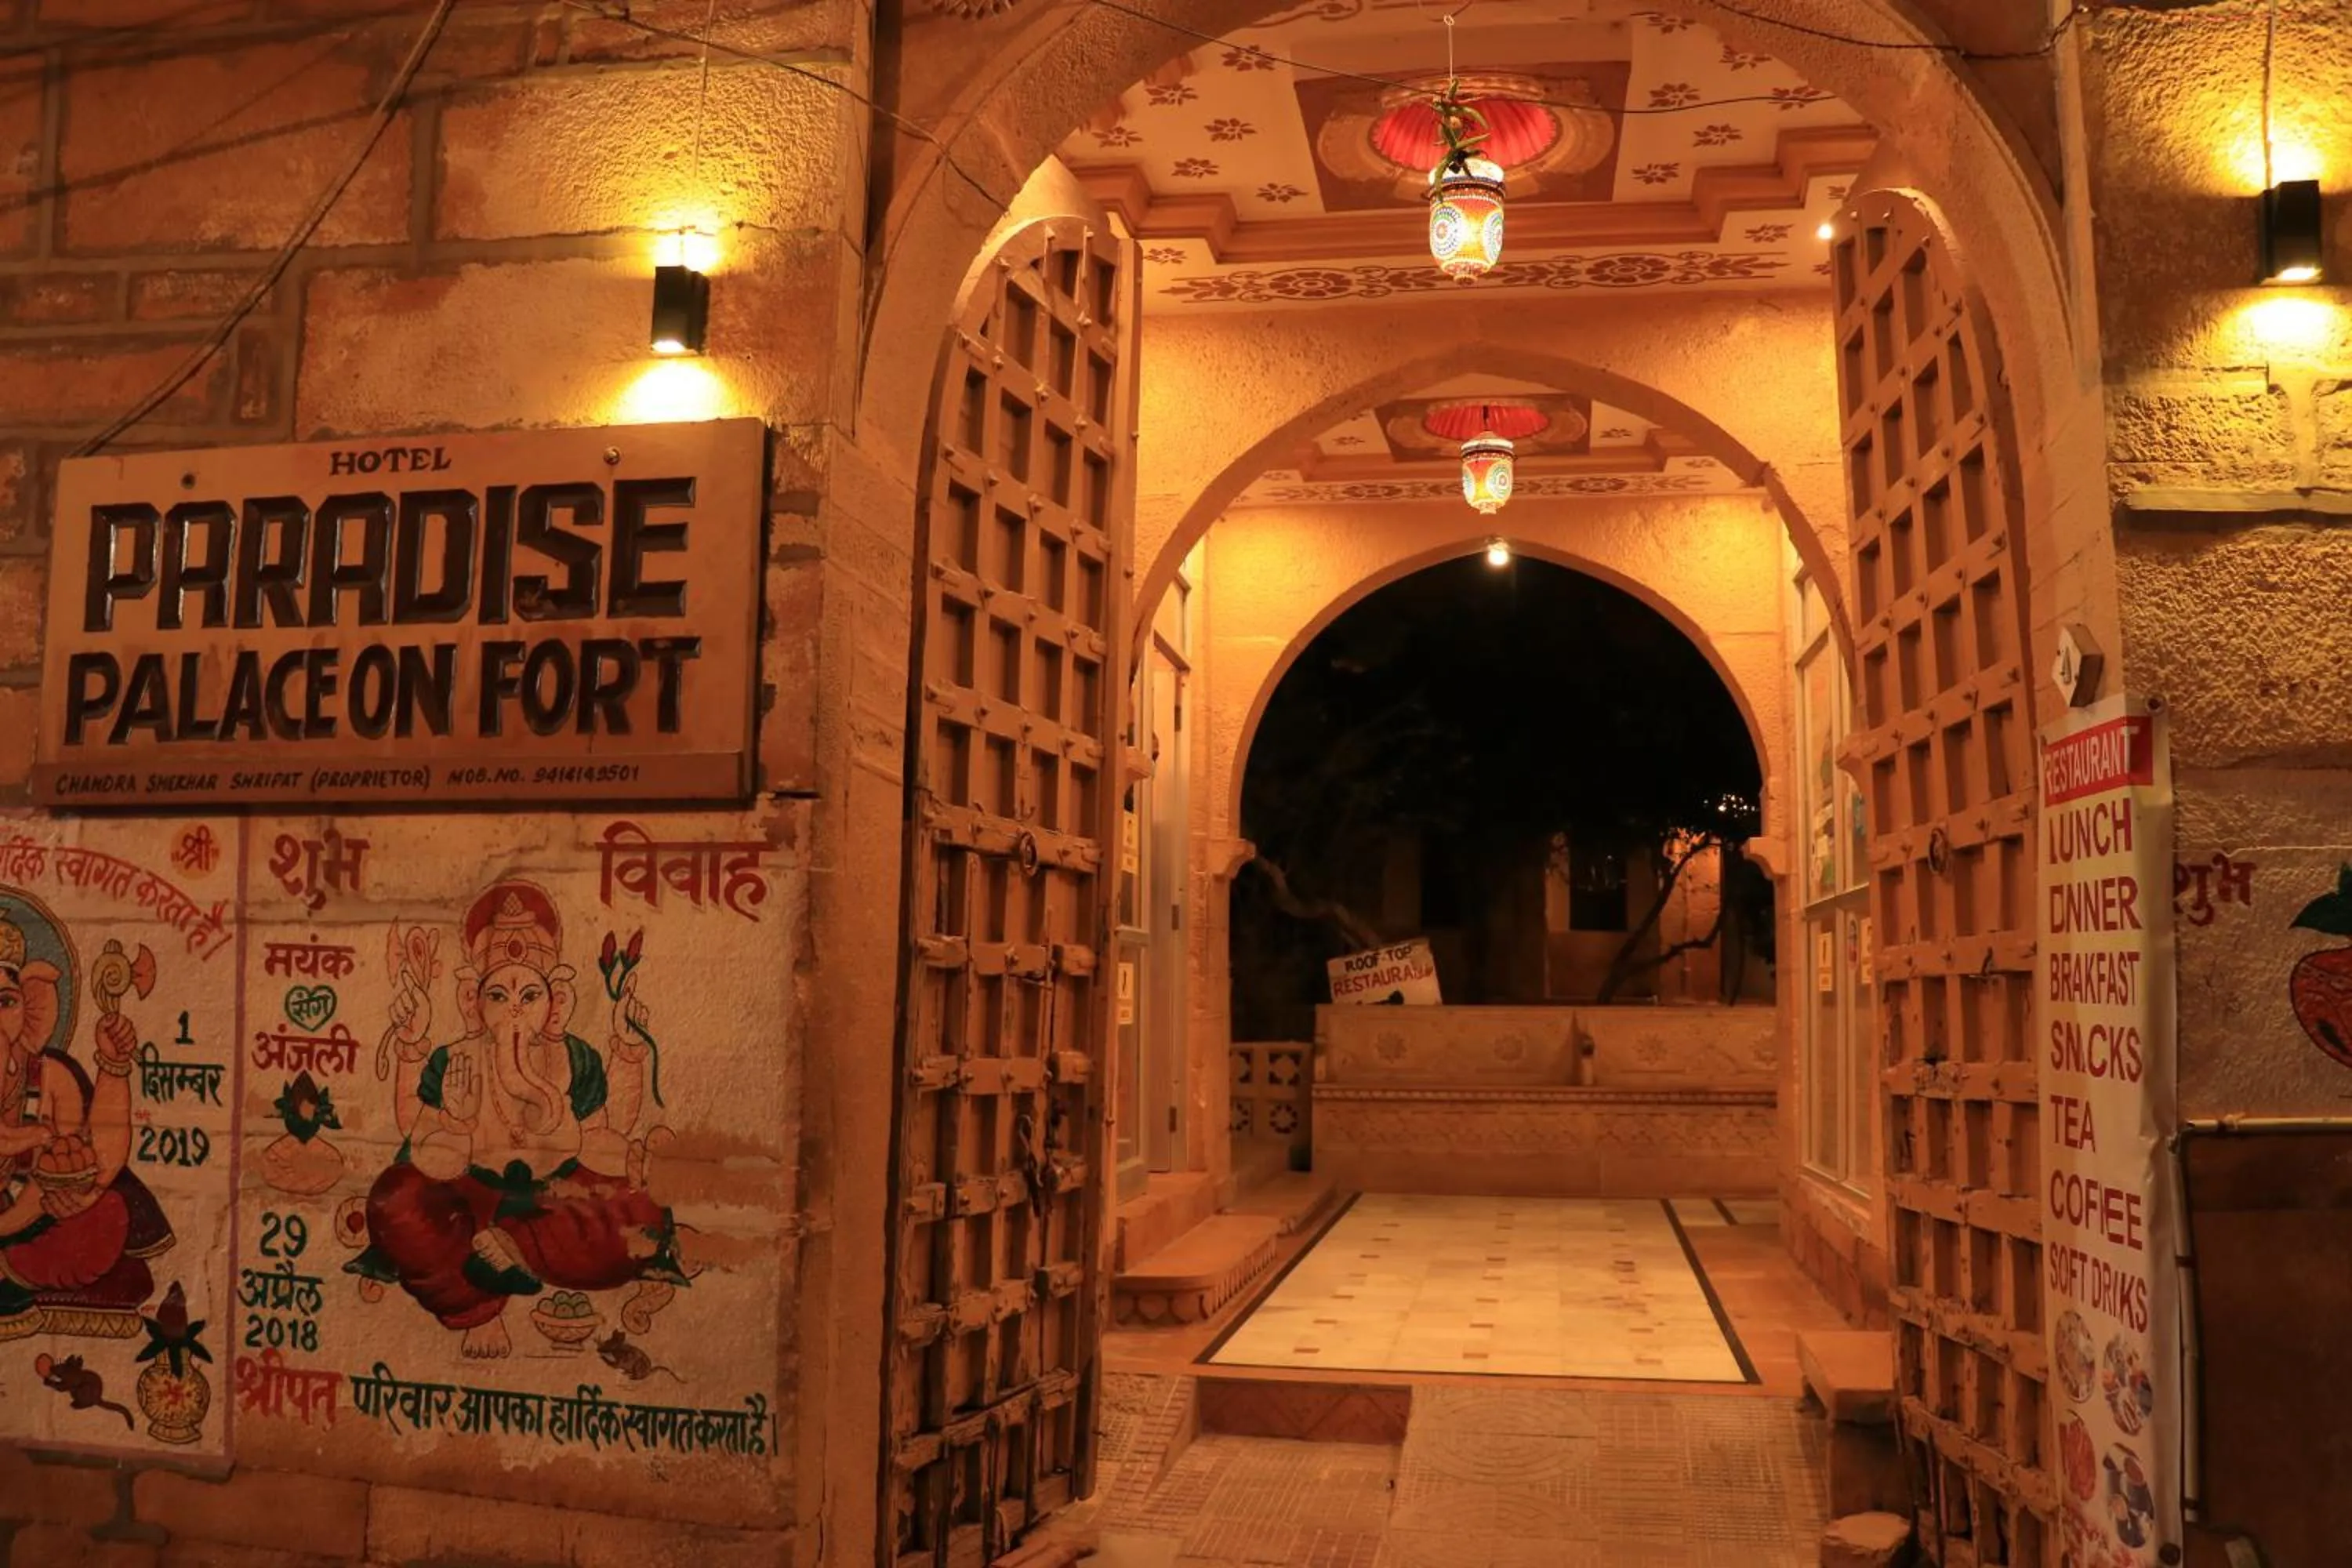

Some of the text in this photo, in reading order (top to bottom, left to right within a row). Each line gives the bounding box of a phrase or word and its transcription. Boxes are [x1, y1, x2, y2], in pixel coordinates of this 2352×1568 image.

[329, 447, 452, 475] HOTEL
[83, 475, 696, 632] PARADISE
[63, 636, 702, 746] PALACE ON FORT
[54, 772, 136, 796] CHANDRA
[310, 764, 431, 793] (PROPRIETOR)
[2043, 725, 2141, 796] RESTAURANT
[2049, 797, 2132, 866] LUNCH
[0, 834, 47, 886] ार्दिक
[55, 846, 141, 902] स्वागत
[269, 820, 779, 923] शुभ विवाह
[2049, 875, 2143, 935] DNNER
[264, 934, 356, 979] मयंक
[1344, 944, 1413, 972] ROOF TOP
[174, 1011, 195, 1046] 1
[251, 1023, 361, 1076] अंजली
[2049, 1018, 2143, 1083] SNCKS
[137, 1127, 211, 1168] 2019
[2049, 1094, 2096, 1153] TEA
[259, 1210, 308, 1258] 29
[238, 1260, 325, 1316] अप्रैल
[2049, 1240, 2148, 1334] SOFT DRIKS
[245, 1314, 320, 1353] 2018
[348, 1361, 457, 1436] परिवार
[454, 1386, 546, 1439] आपका
[548, 1383, 624, 1451] हार्दिक
[621, 1403, 699, 1454] स्वागत
